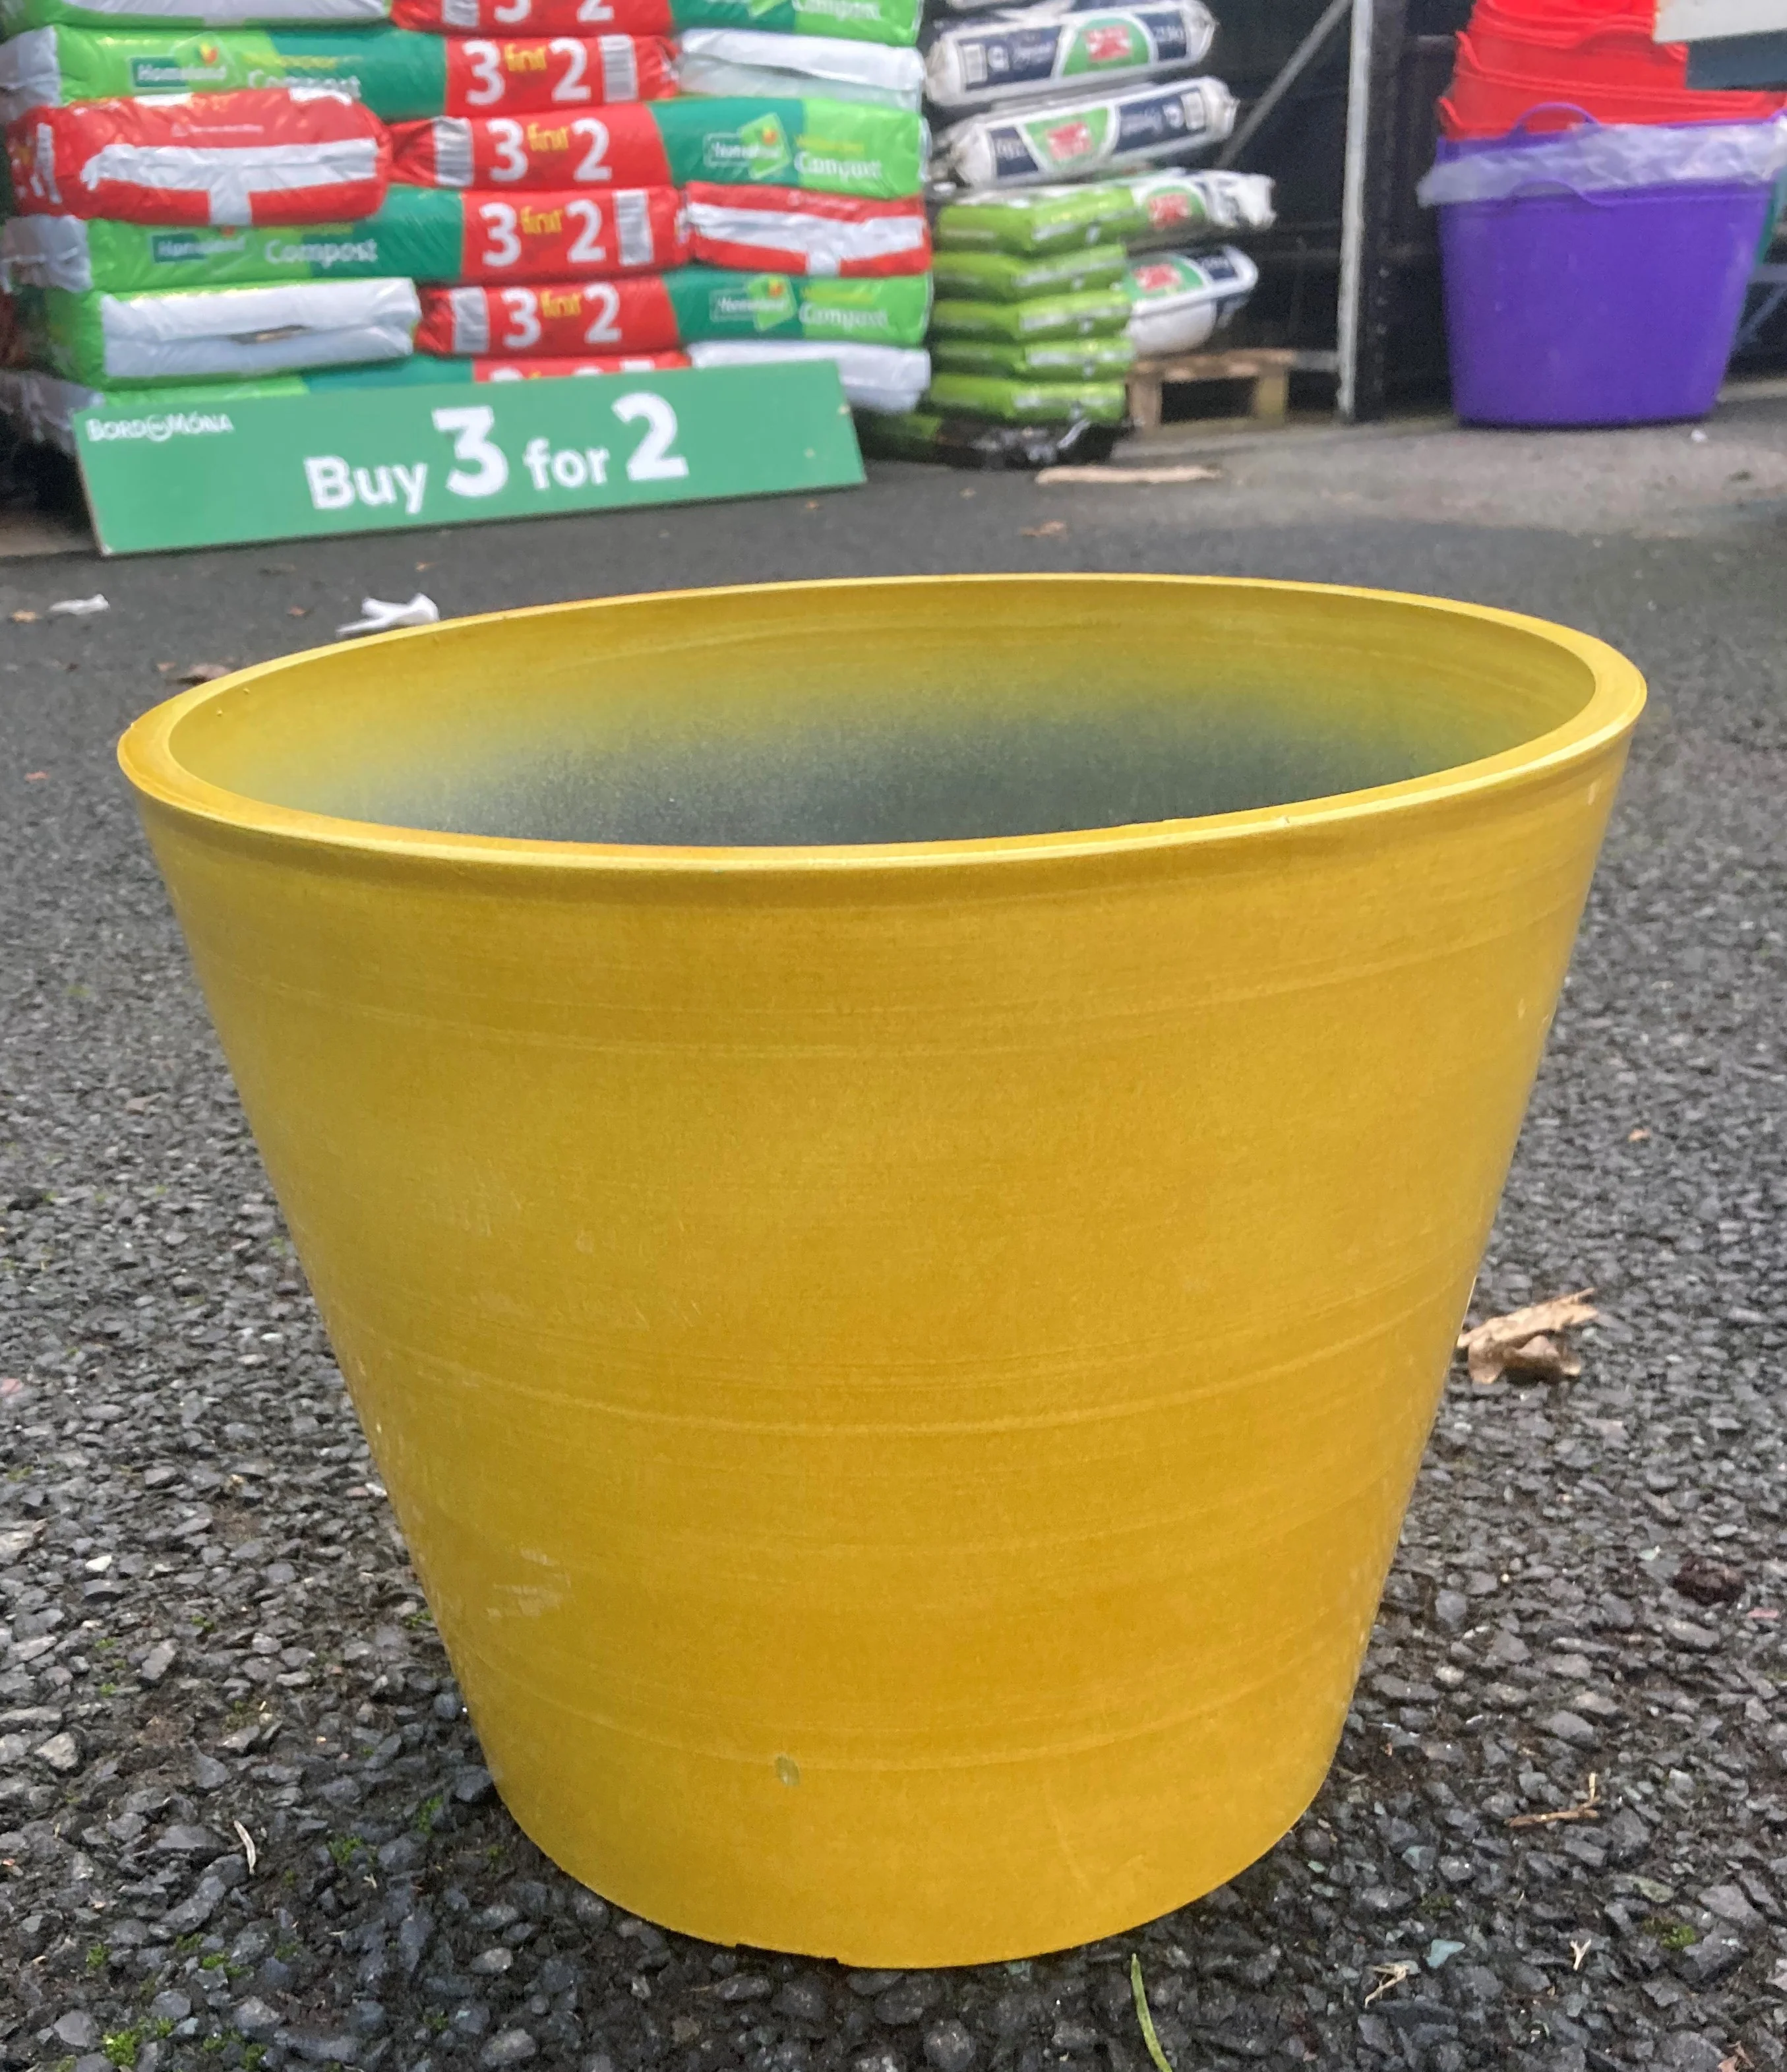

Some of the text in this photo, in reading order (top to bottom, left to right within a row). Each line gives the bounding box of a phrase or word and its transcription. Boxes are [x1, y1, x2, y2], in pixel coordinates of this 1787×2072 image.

[463, 40, 505, 106] 3
[547, 38, 591, 102] 2
[485, 118, 528, 182] 3
[570, 117, 613, 181] 2
[265, 239, 379, 268] Compost
[479, 202, 521, 266] 3
[565, 199, 606, 263] 2
[500, 287, 542, 348] 3
[583, 282, 622, 344] 2
[303, 390, 689, 514] Buy 3 for 2
